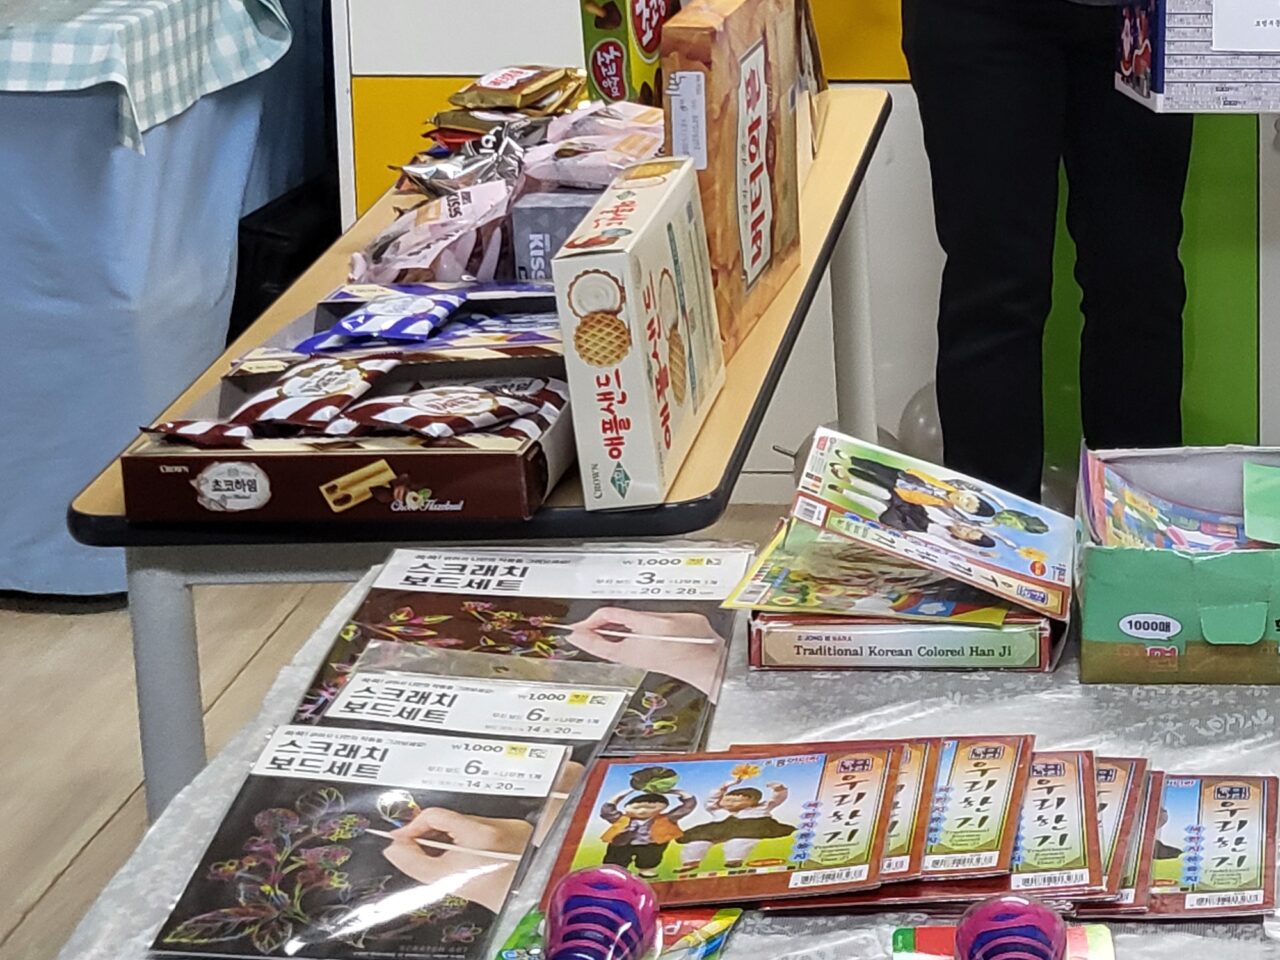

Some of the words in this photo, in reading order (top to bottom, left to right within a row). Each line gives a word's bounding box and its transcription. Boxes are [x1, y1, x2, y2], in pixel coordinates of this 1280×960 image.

[596, 368, 632, 461] 애플샌드
[593, 463, 602, 499] CROWN
[406, 561, 529, 578] 스크래치
[400, 574, 522, 592] 보드세트
[1127, 619, 1171, 631] 1000매
[794, 645, 863, 657] Traditional
[868, 646, 913, 657] Korean
[917, 645, 965, 657] Colored
[969, 646, 995, 657] Han
[999, 645, 1012, 657] Ji
[350, 686, 459, 708] 스크래치
[339, 700, 449, 724] 보드세트
[274, 739, 390, 763] 스크래치
[265, 755, 382, 780] 보드세트
[823, 774, 870, 843] 우리한지
